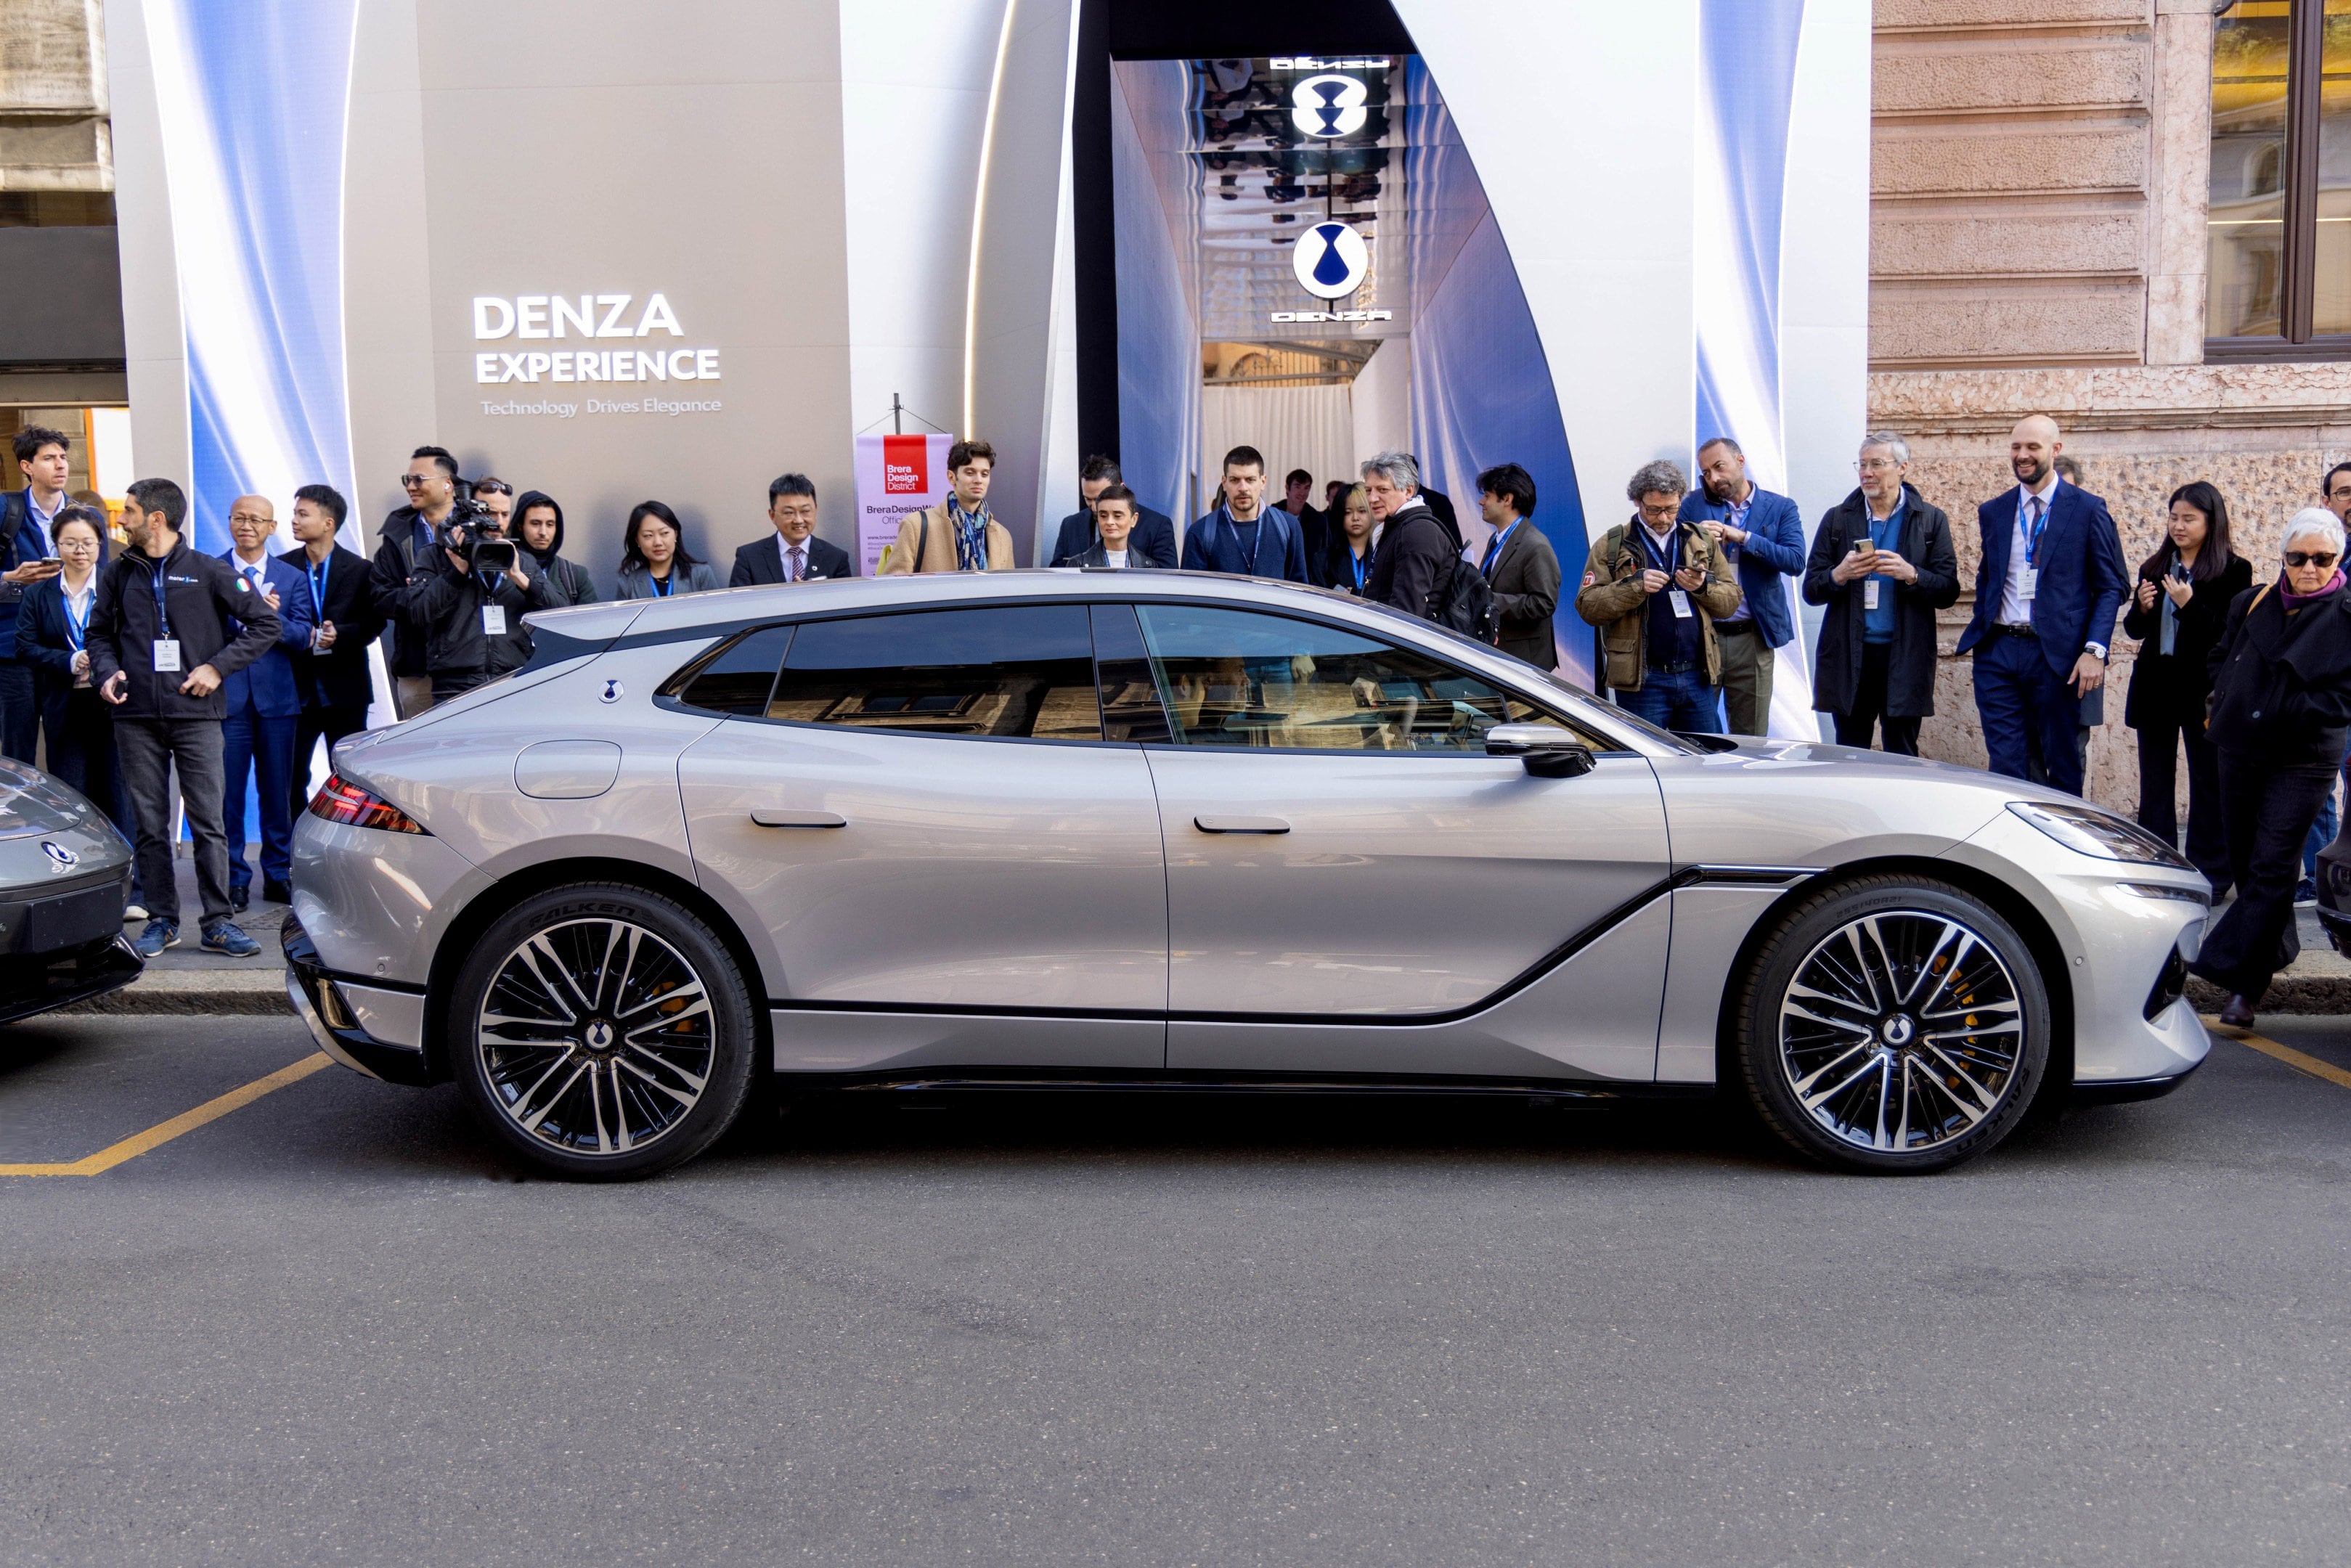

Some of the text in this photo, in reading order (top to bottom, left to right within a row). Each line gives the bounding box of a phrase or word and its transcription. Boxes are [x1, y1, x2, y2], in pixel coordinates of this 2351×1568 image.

[473, 293, 685, 340] DENZA
[1271, 311, 1392, 323] DENZA
[476, 349, 721, 383] EXPERIENCE
[481, 399, 722, 418] Technology Drives Elegance
[887, 473, 918, 483] Design
[866, 505, 934, 513] BreraDesignW
[529, 902, 635, 928] FALKEN
[1957, 1065, 2031, 1152] FALKEN
